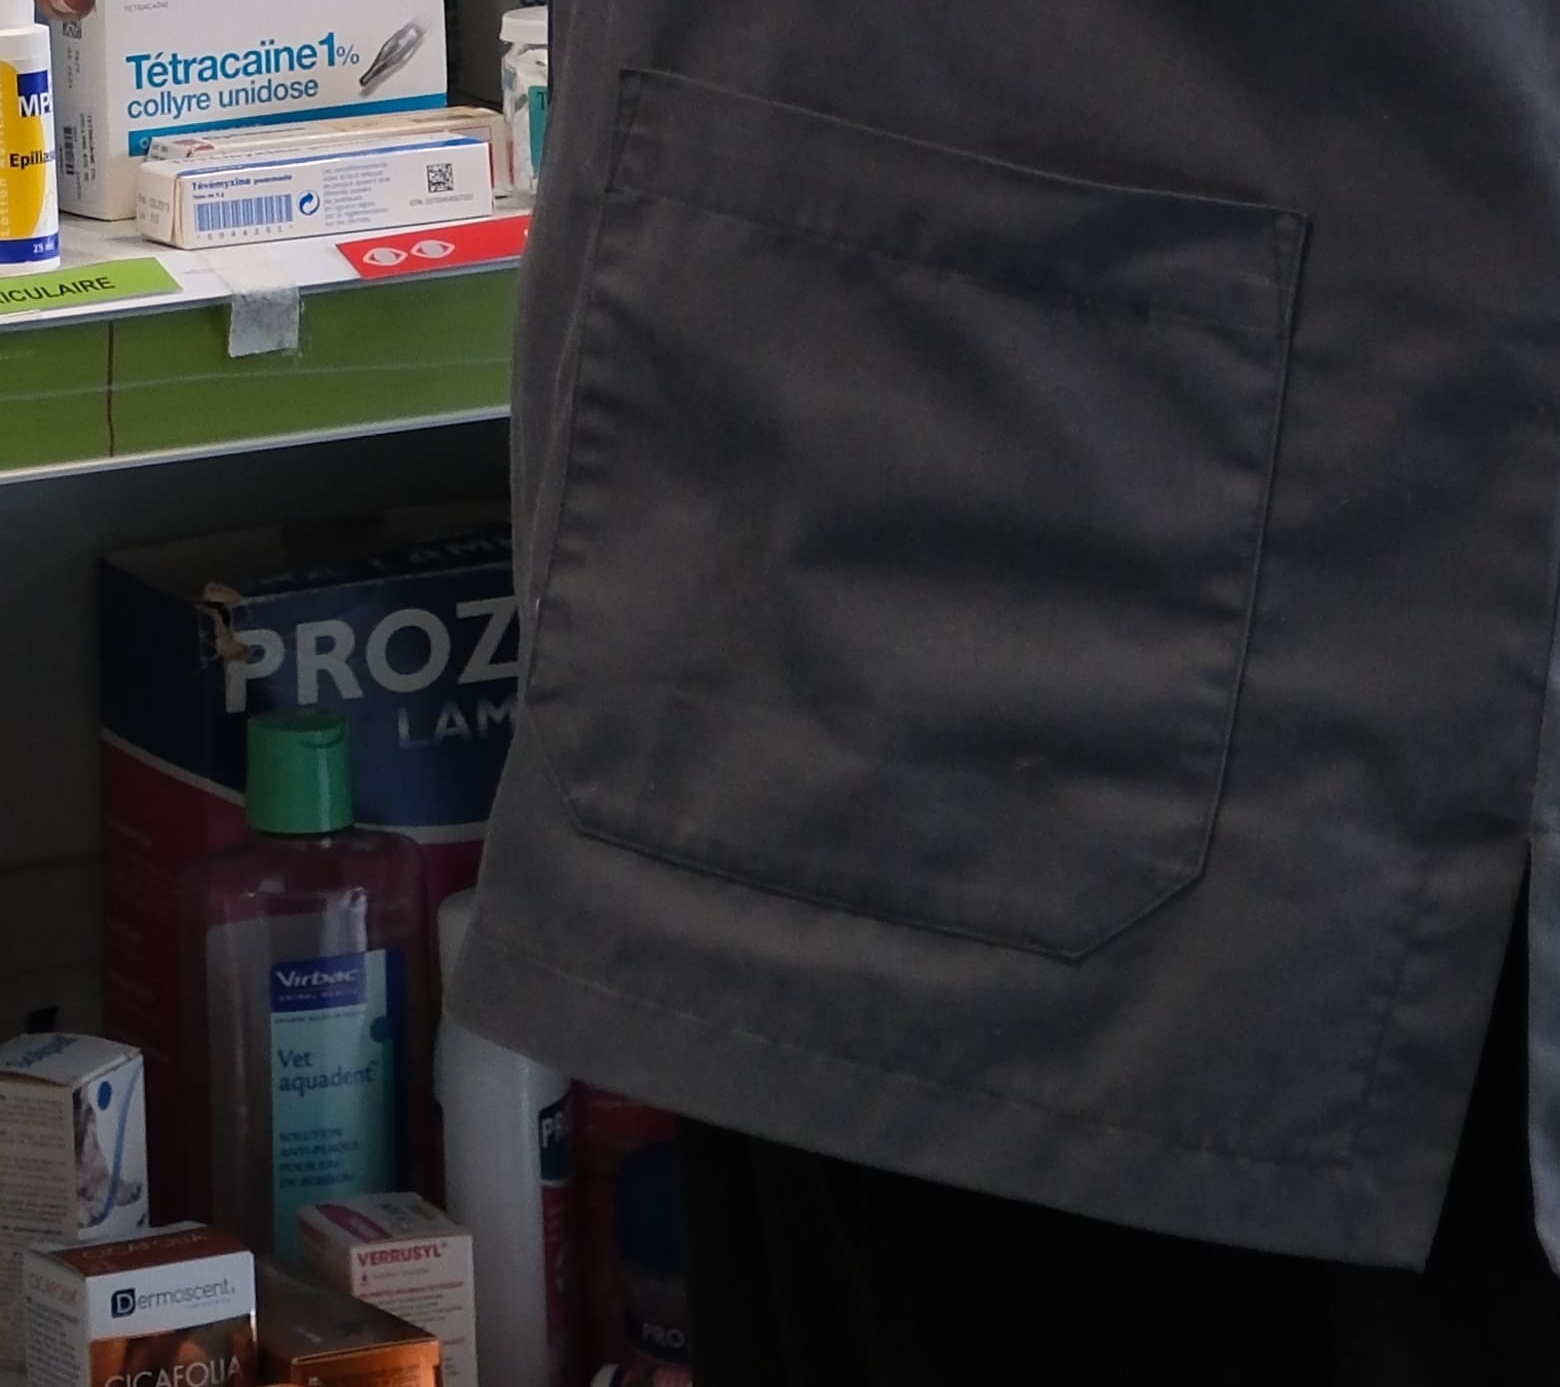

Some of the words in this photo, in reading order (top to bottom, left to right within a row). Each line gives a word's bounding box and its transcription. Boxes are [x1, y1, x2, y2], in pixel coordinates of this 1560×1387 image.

[125, 38, 317, 91] Tétracaïne
[126, 88, 212, 122] collyre
[218, 75, 320, 109] unidose
[191, 176, 253, 192] Tévémyxine
[275, 967, 362, 993] Virbac
[278, 1048, 313, 1071] Vet
[278, 1066, 376, 1101] aquadent
[356, 1244, 443, 1270] VERRUSYL
[110, 1276, 235, 1320] Dermoscent
